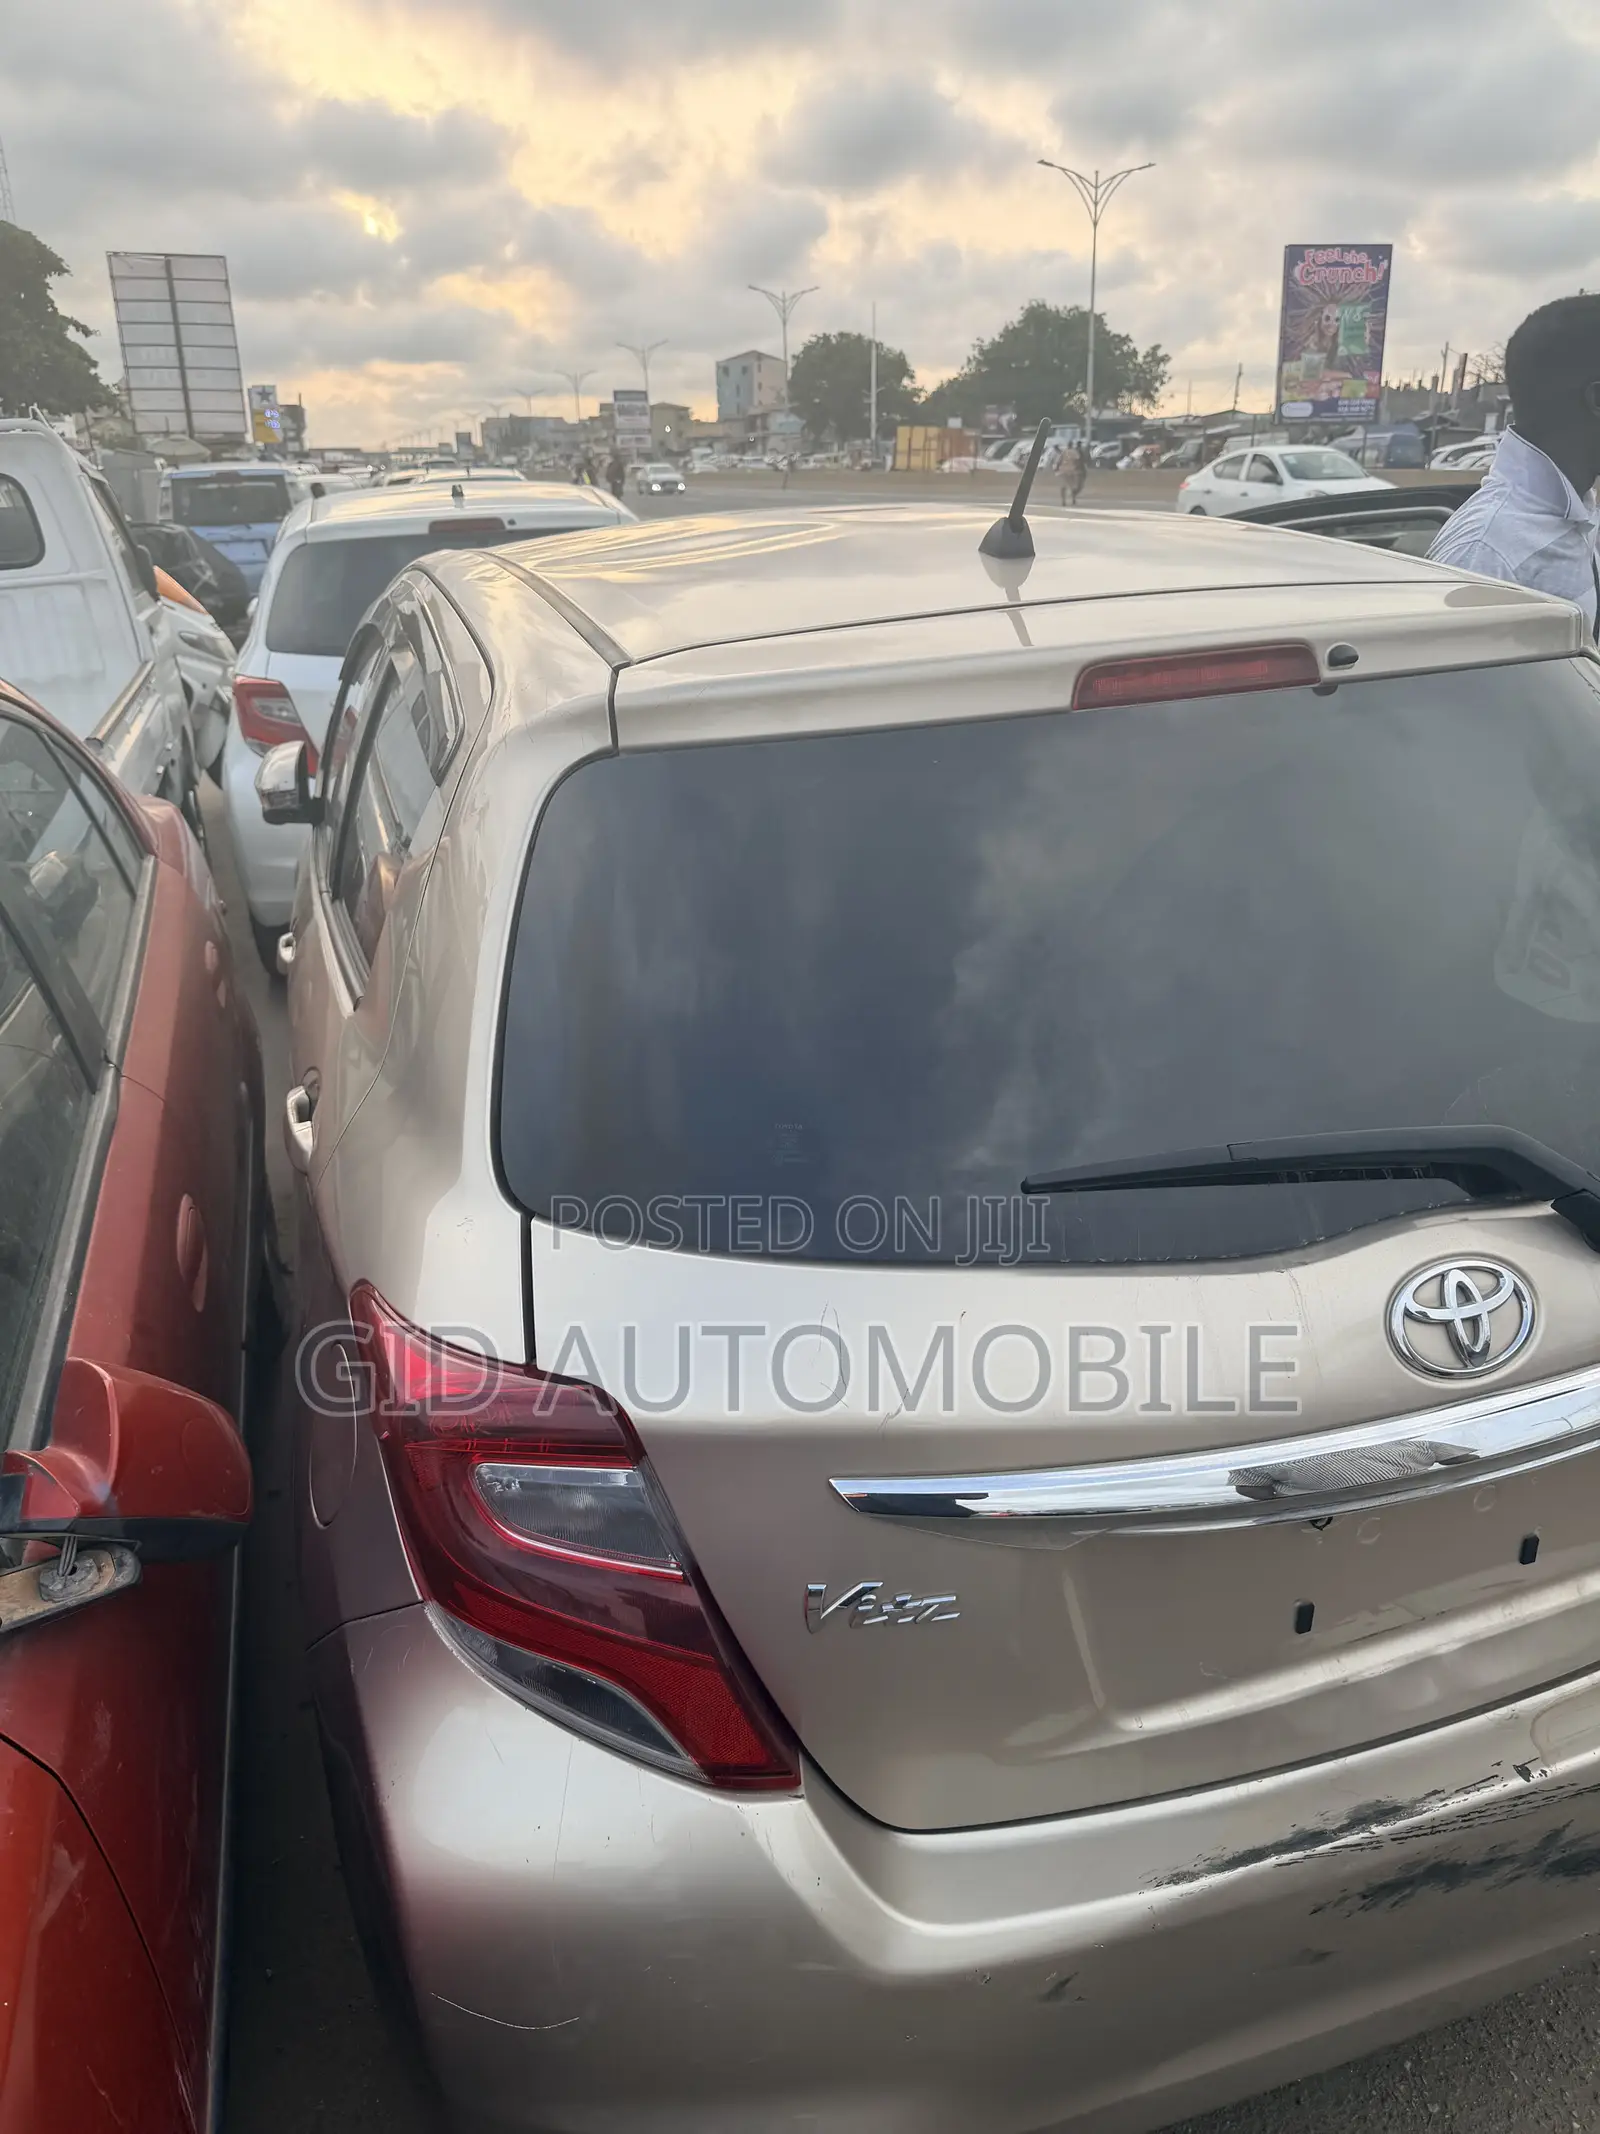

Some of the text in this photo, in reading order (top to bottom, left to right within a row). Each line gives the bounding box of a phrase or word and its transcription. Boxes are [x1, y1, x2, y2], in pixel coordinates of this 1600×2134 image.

[1304, 248, 1369, 265] Feel the
[1299, 262, 1386, 285] Crunch!
[804, 1581, 960, 1634] Vitz
